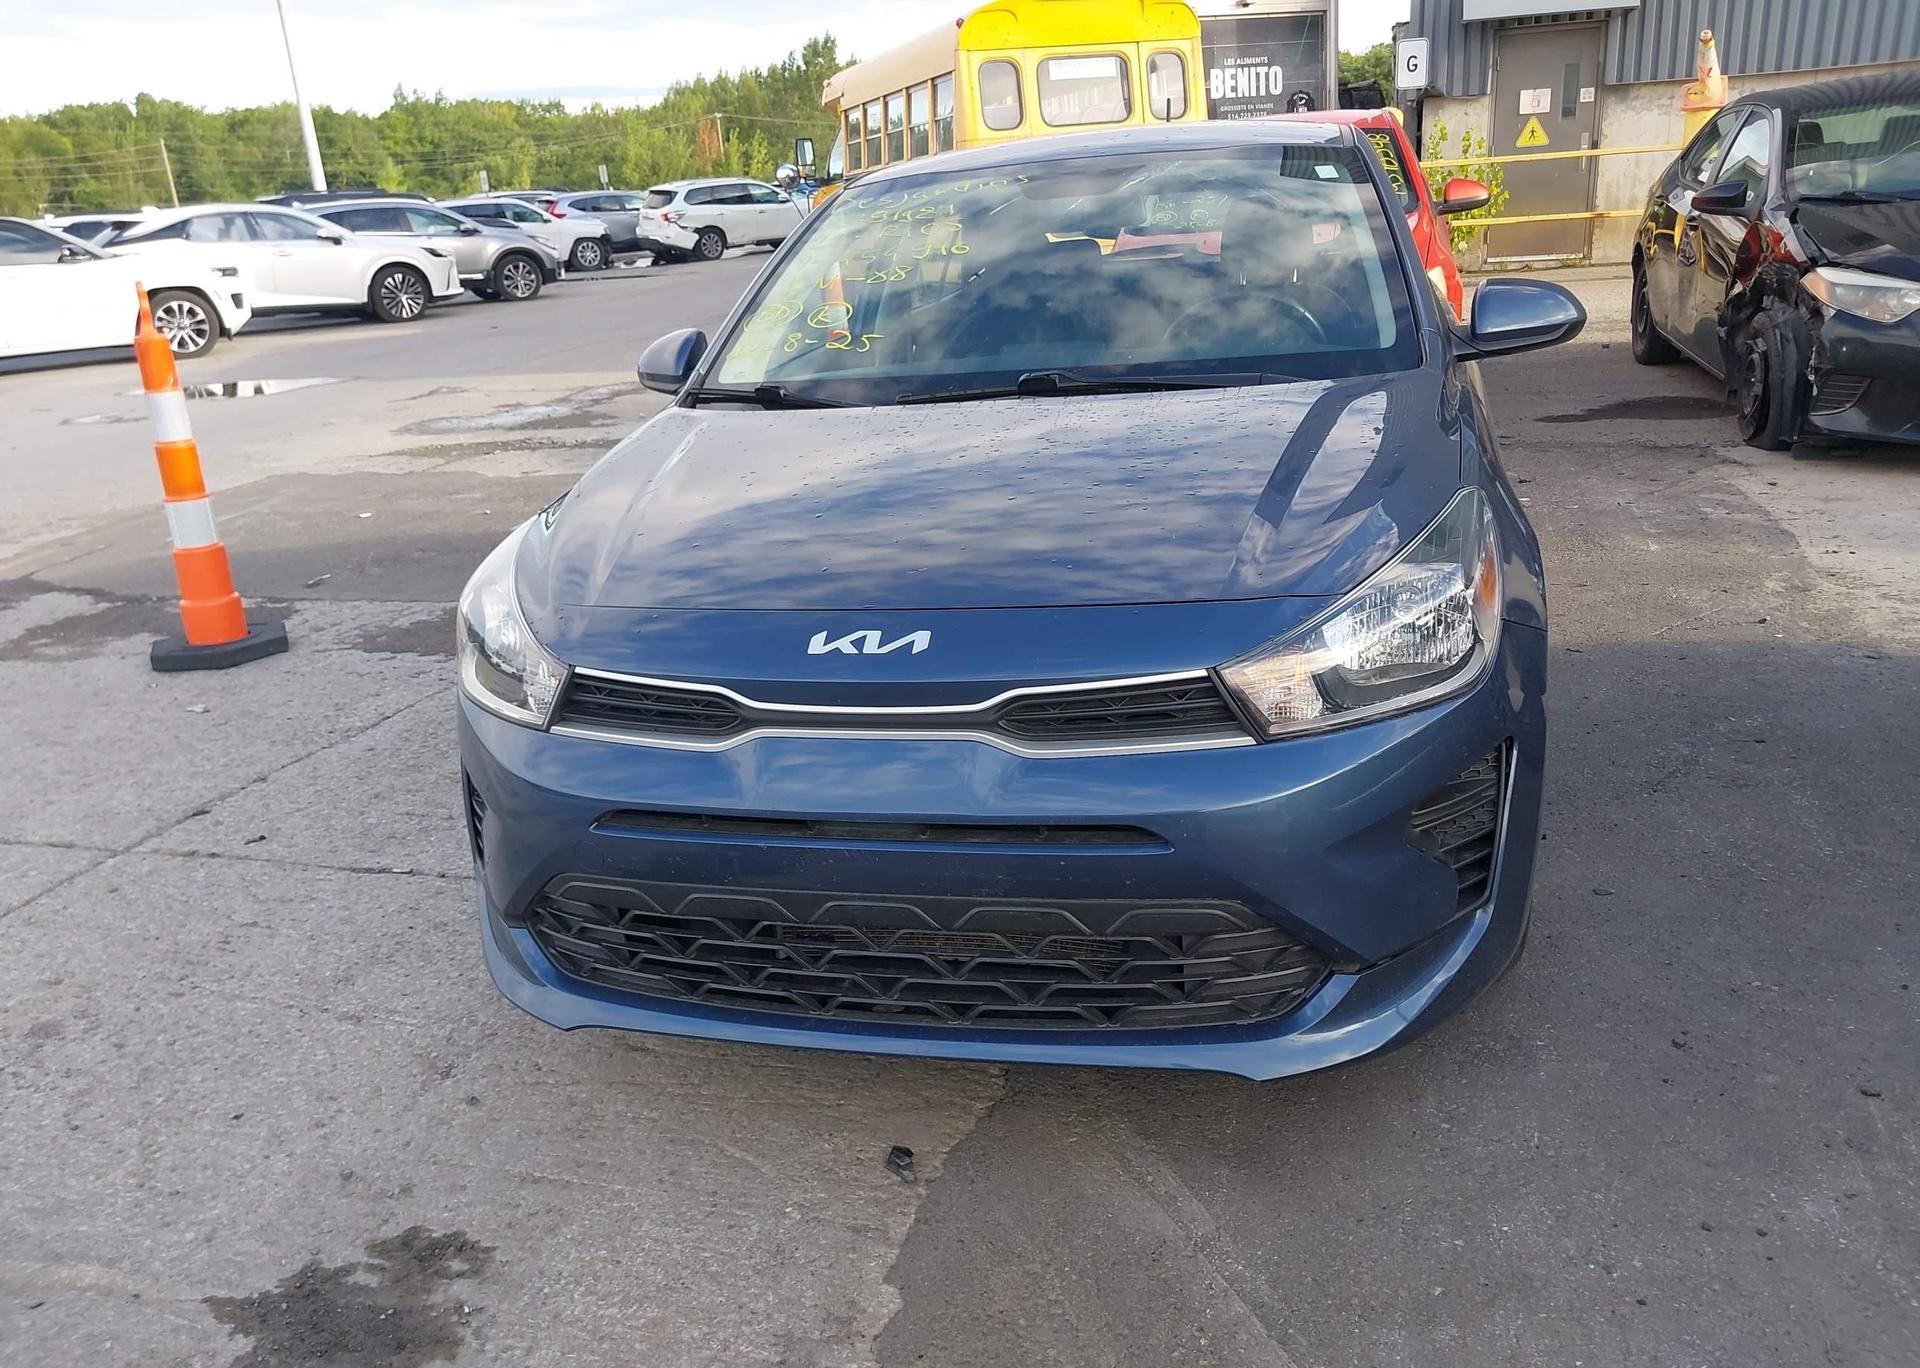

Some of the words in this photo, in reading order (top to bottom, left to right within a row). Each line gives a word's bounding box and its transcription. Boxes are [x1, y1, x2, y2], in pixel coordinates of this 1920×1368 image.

[1223, 57, 1235, 66] LES
[1236, 56, 1269, 65] ALIMENTS
[1406, 55, 1418, 73] G
[1210, 65, 1283, 100] BENITO
[807, 630, 932, 655] KIA
